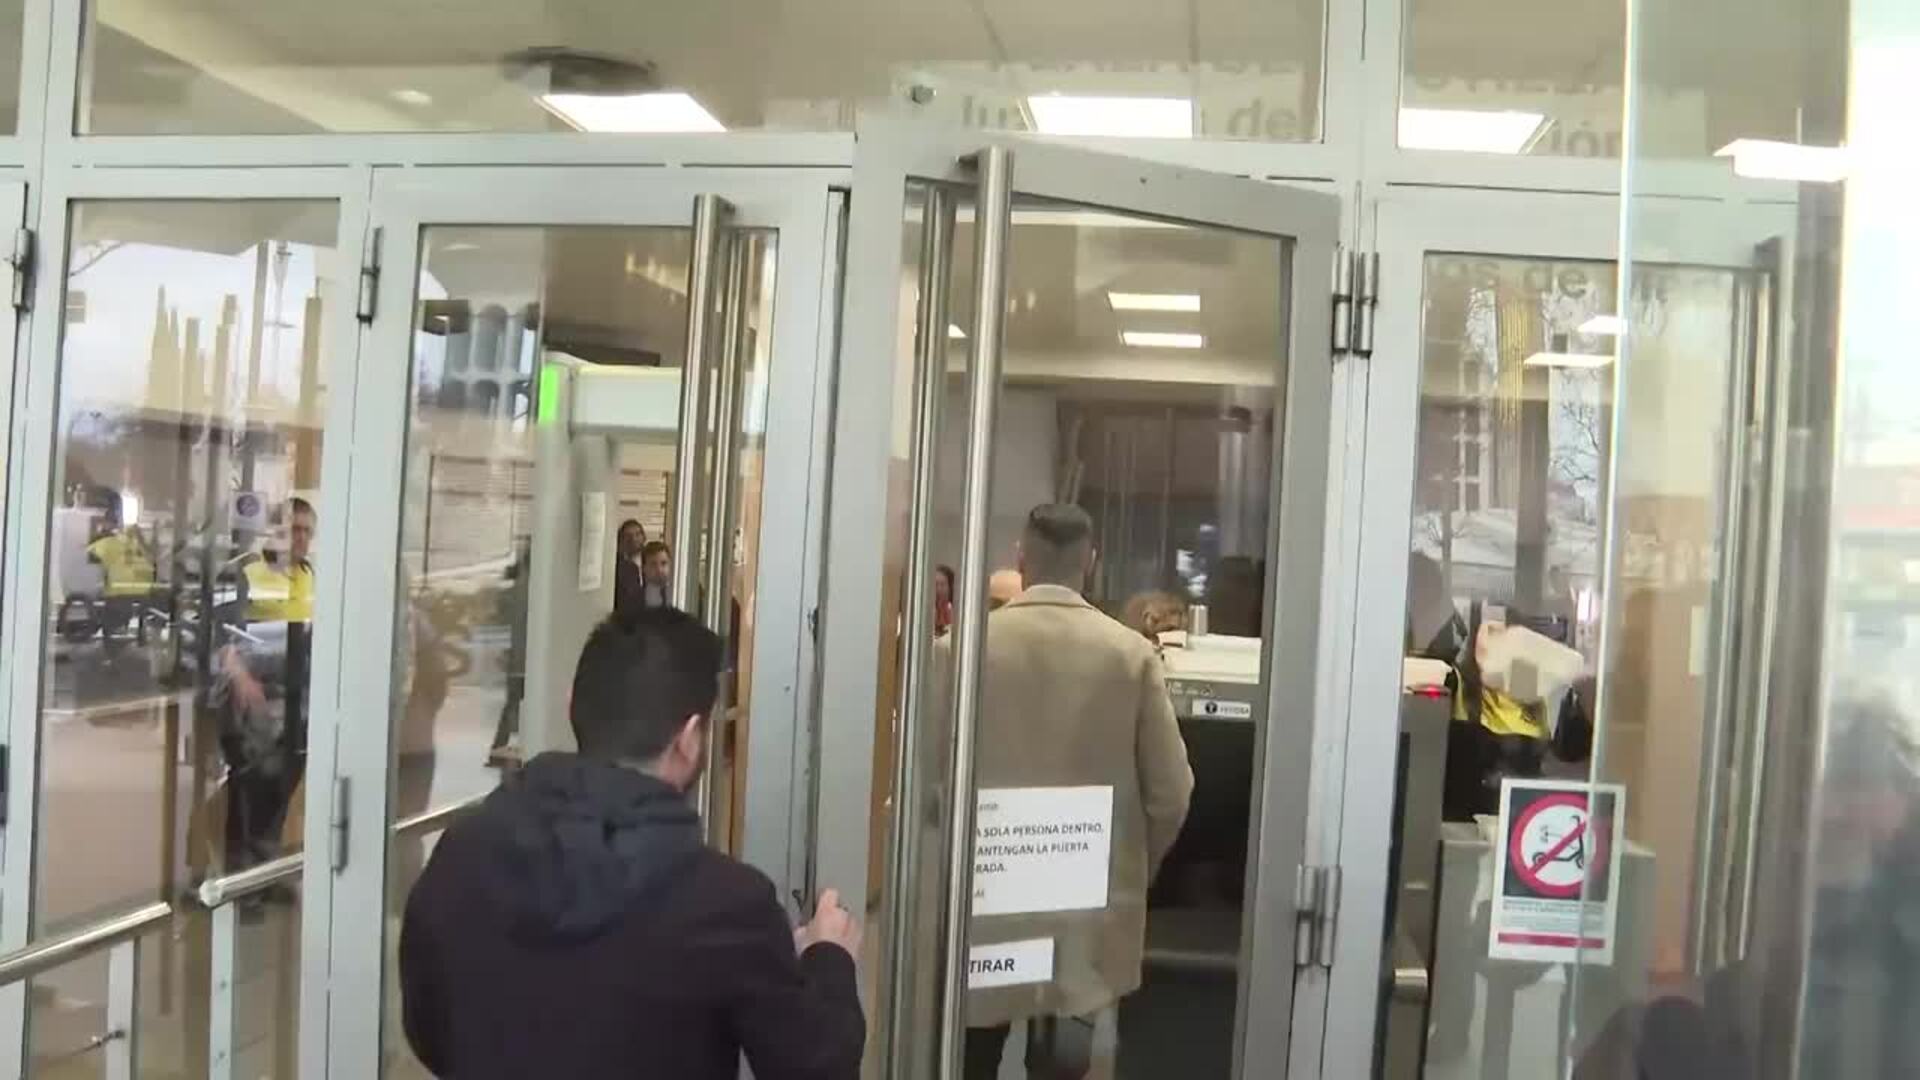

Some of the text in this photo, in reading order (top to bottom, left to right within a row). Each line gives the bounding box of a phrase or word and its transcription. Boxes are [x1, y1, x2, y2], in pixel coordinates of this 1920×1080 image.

[983, 826, 1010, 837] SOLA
[1012, 824, 1060, 836] PERSONA
[977, 842, 1089, 856] ANTENGAN LA PUERTA
[975, 863, 1008, 873] RADA.
[970, 958, 1015, 973] TIRAR
